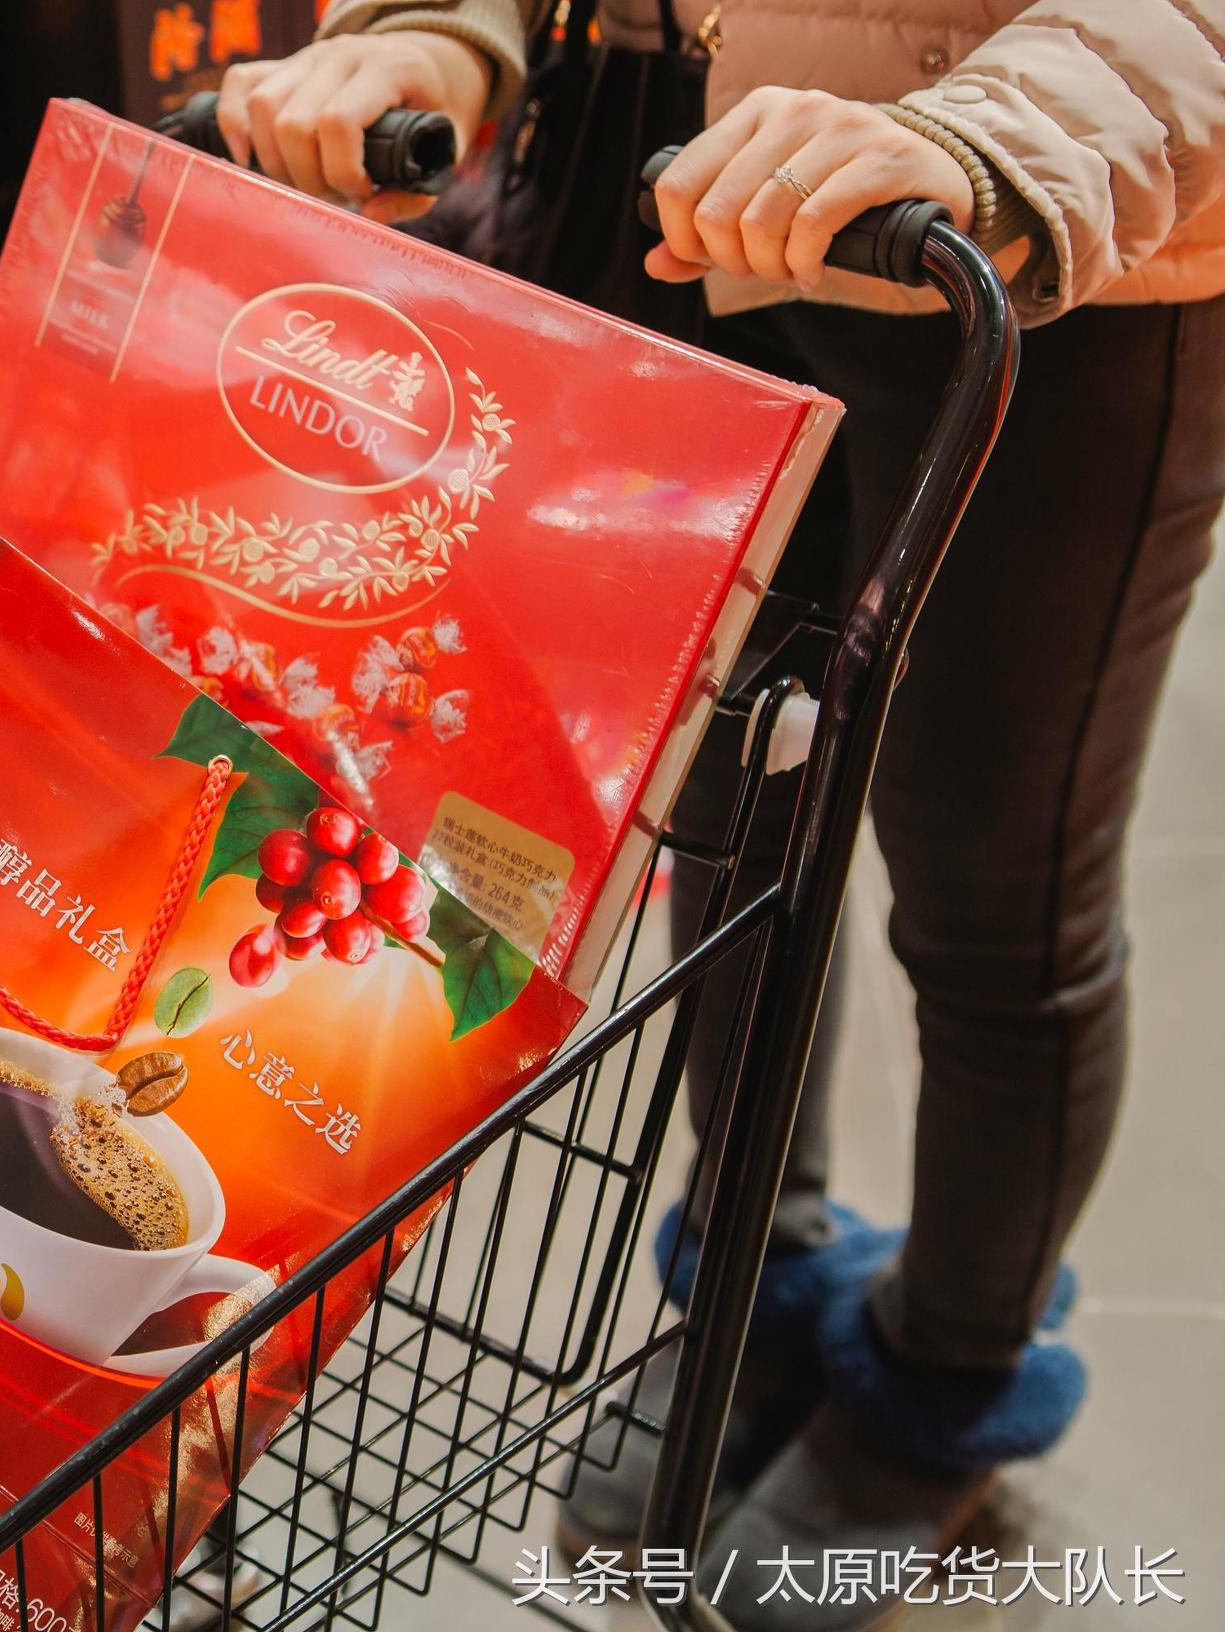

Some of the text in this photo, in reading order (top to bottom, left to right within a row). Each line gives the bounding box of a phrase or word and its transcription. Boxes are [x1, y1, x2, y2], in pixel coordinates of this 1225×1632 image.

[261, 310, 399, 390] Lindt
[249, 375, 388, 462] LINDOR
[220, 1029, 362, 1154] 心意之选
